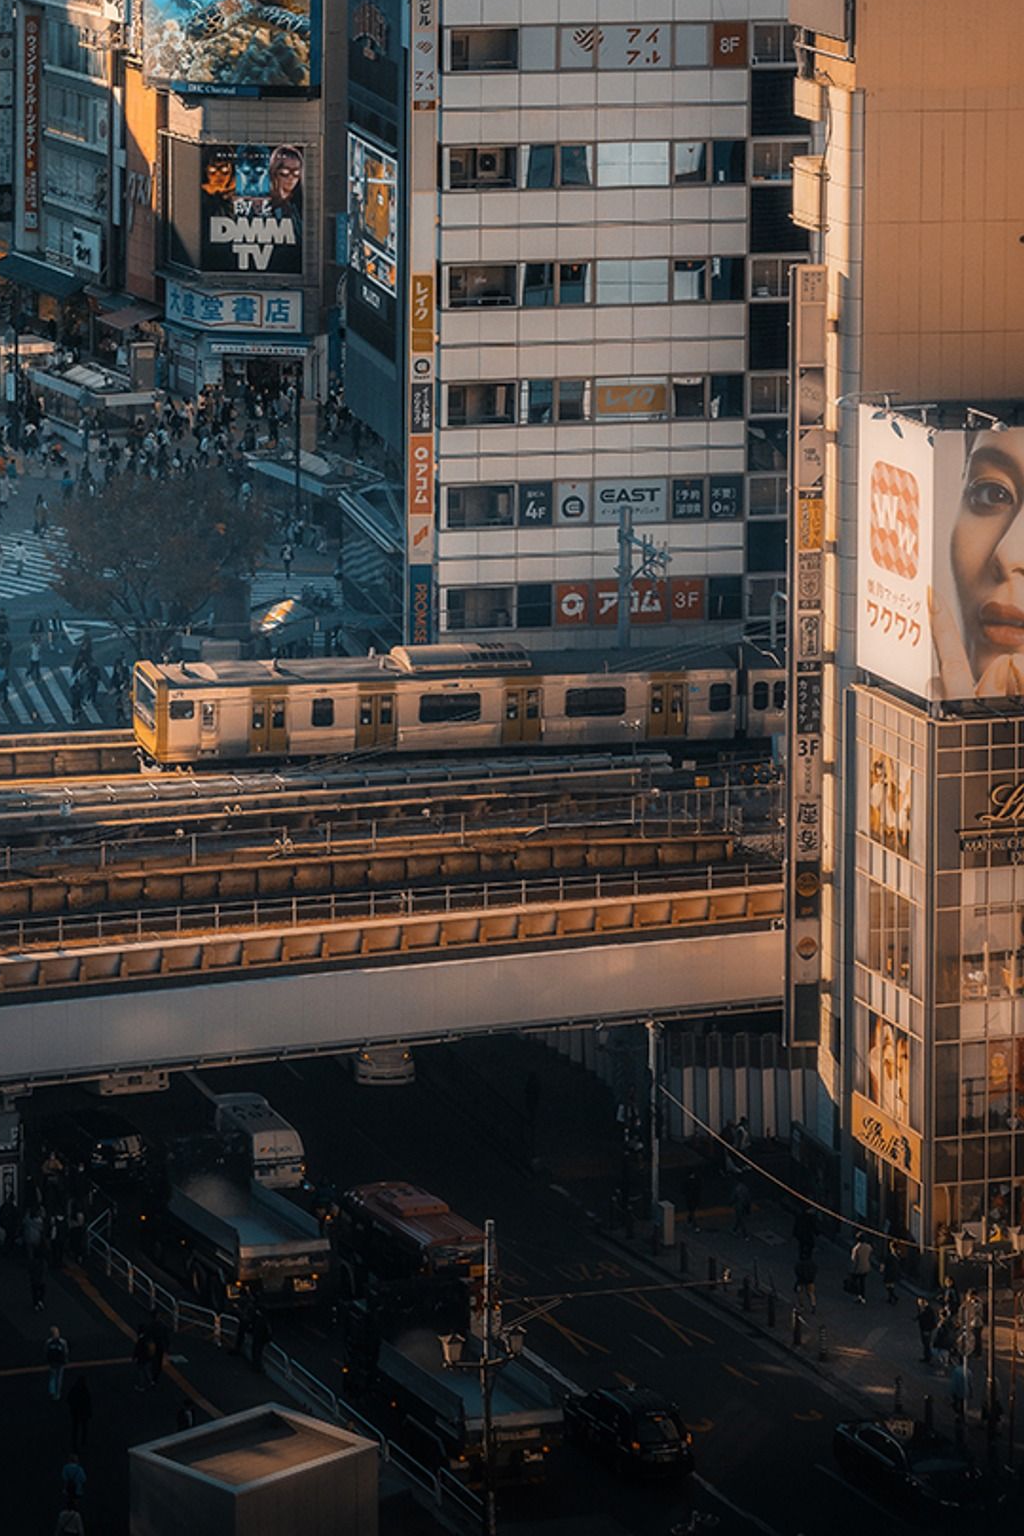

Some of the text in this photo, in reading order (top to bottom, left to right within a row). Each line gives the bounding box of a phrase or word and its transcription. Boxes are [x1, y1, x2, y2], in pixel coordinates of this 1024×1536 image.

[720, 36, 741, 53] 8F
[210, 215, 296, 245] DMM
[232, 244, 274, 270] TV
[599, 487, 661, 504] EAST
[525, 501, 546, 519] 4F
[675, 591, 699, 608] 3F
[415, 584, 427, 644] PROMISE
[798, 740, 819, 757] 3F
